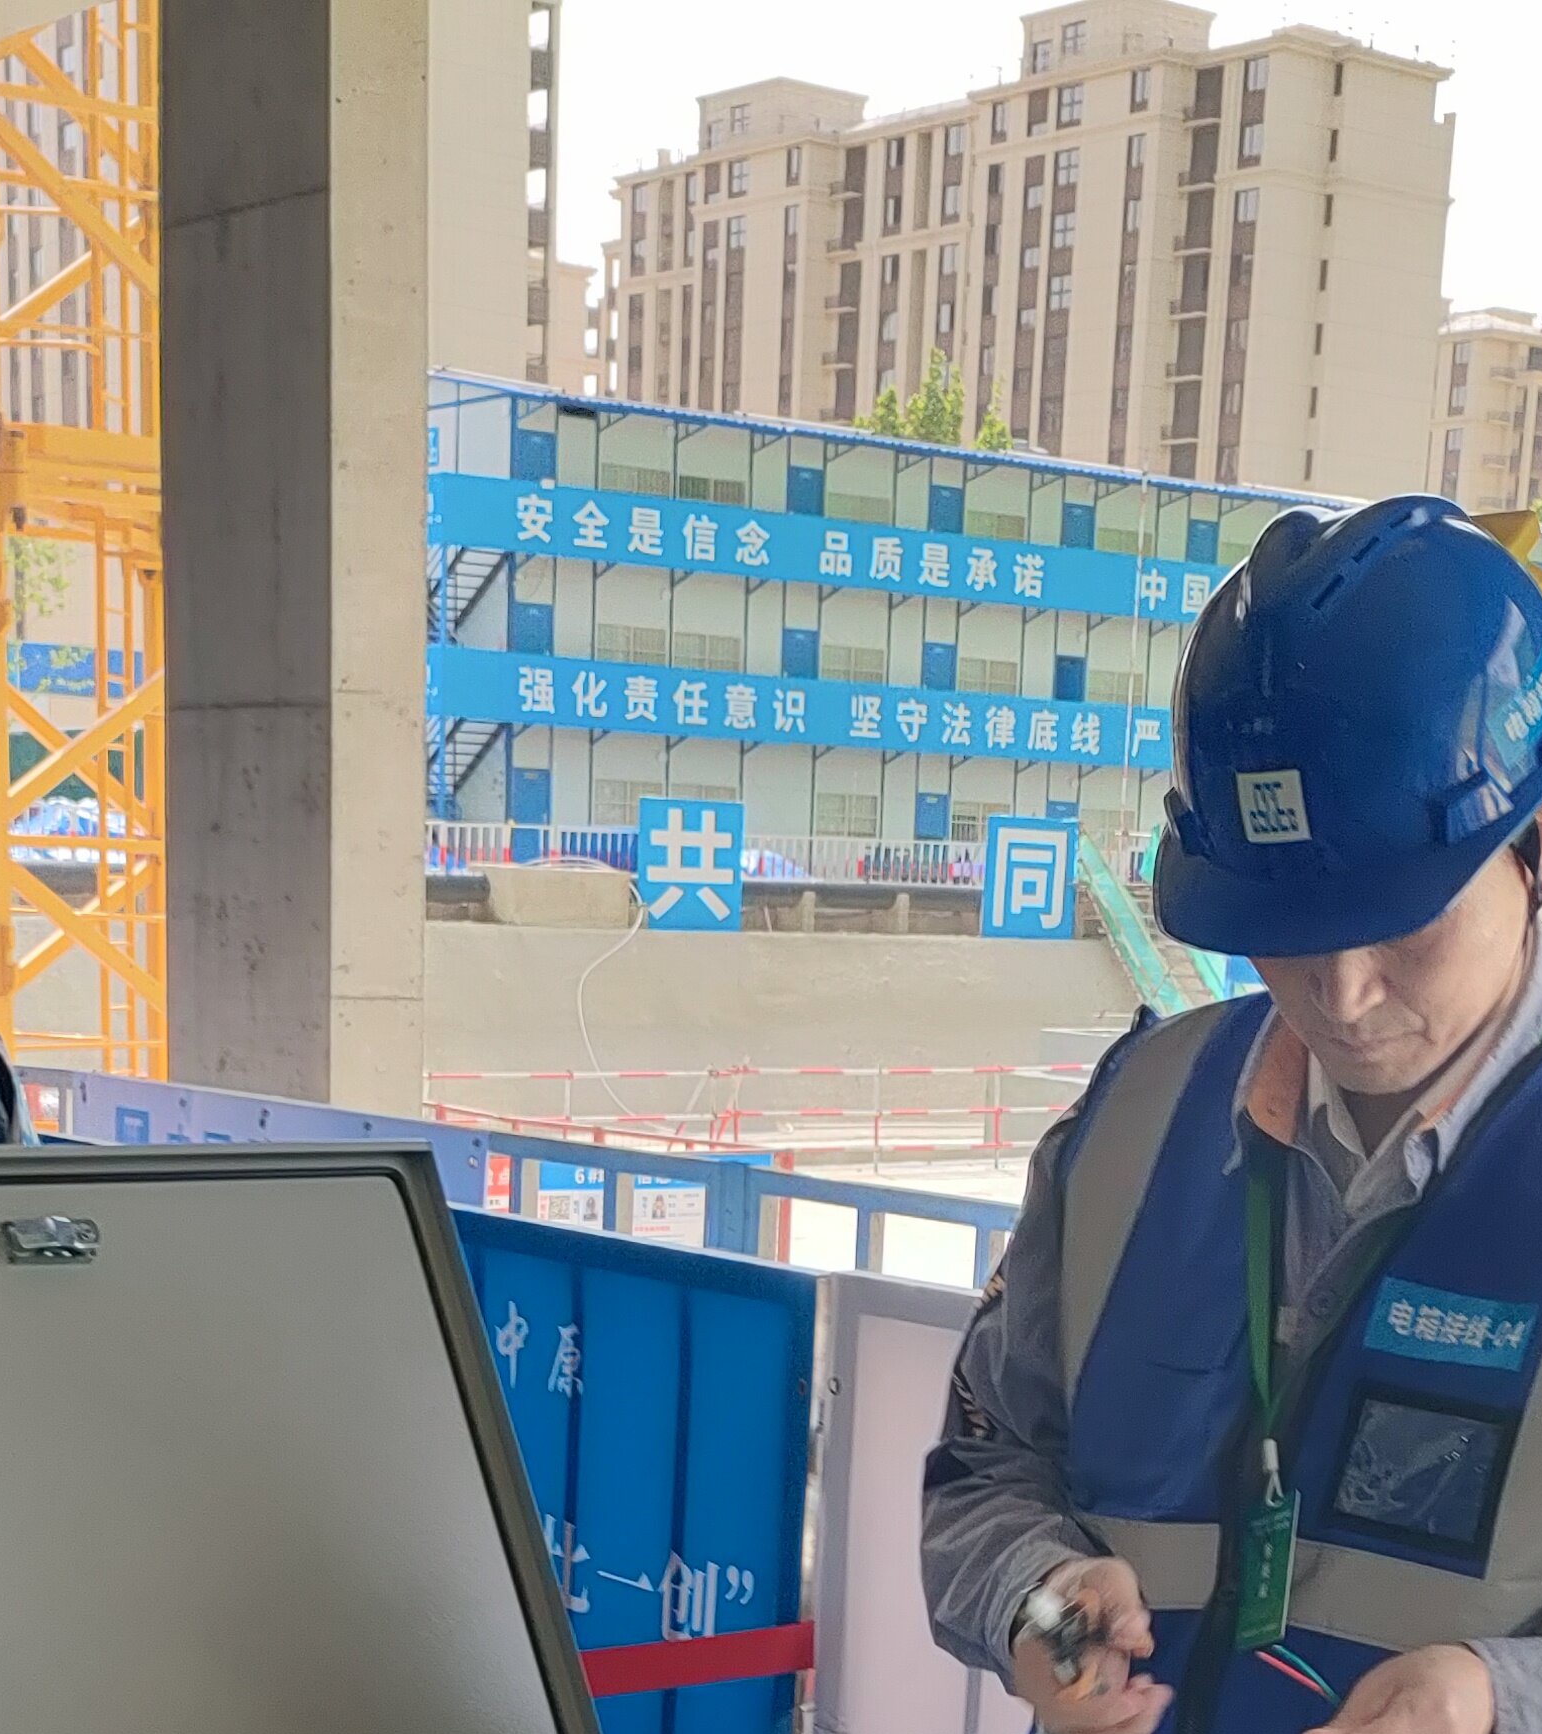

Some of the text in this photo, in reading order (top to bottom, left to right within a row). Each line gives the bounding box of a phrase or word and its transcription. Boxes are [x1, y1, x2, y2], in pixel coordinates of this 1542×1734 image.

[515, 493, 771, 567] 安全是信念
[818, 530, 1045, 600] 品质是承诺
[1140, 567, 1211, 615] 中国
[517, 666, 1162, 759] 强化责任意识 坚守法律底线 严
[646, 807, 736, 922] 共
[991, 827, 1068, 931] 同
